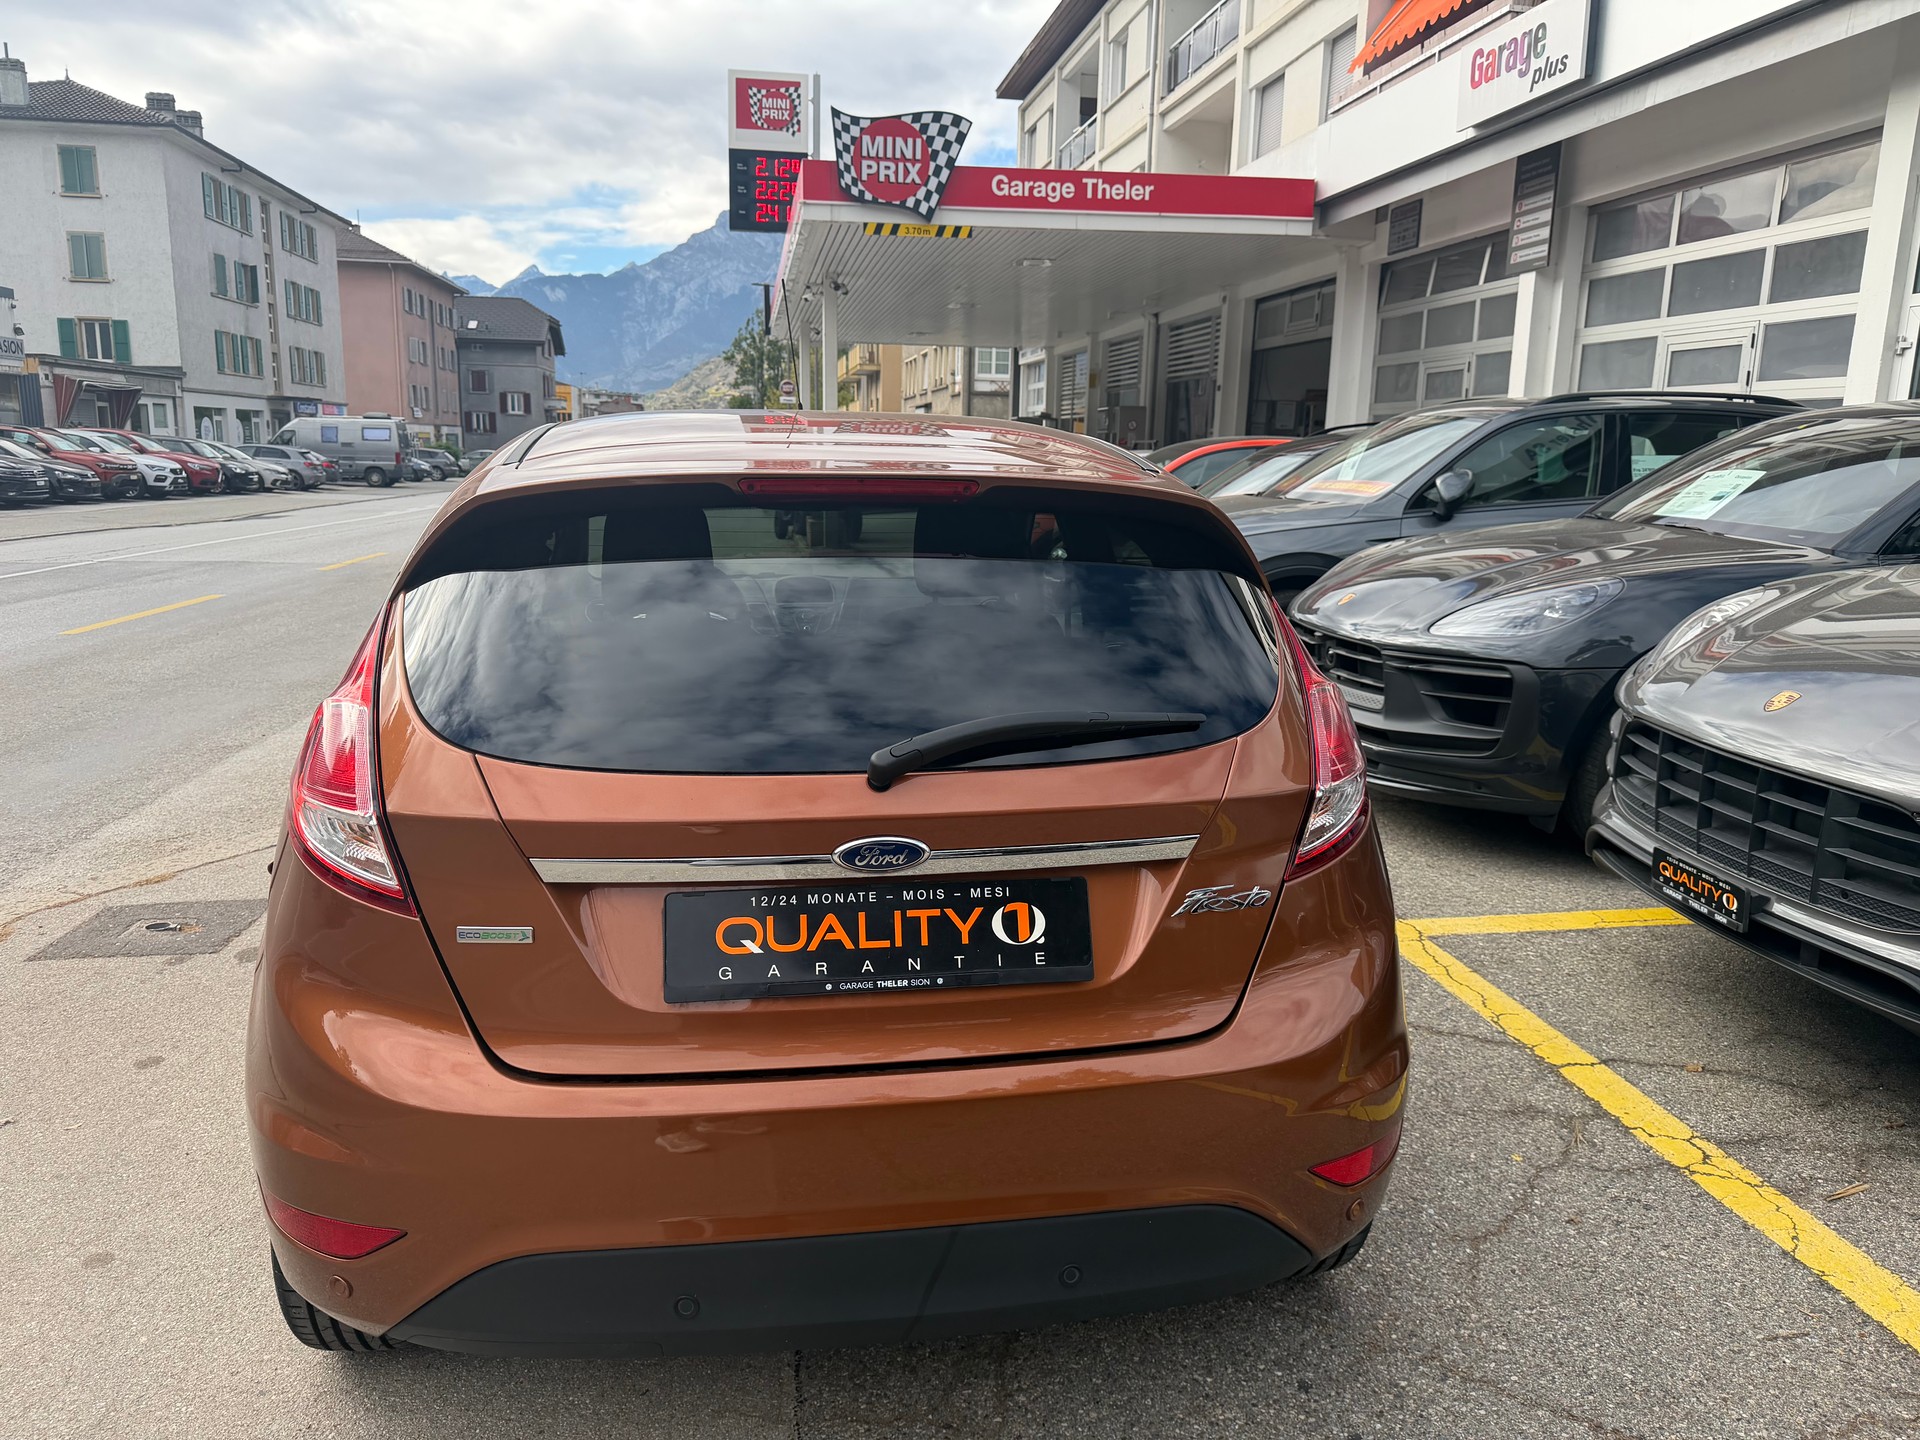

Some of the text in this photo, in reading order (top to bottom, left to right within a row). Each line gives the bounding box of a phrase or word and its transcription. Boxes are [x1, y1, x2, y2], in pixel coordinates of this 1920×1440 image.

[1470, 22, 1547, 90] Garage
[1529, 54, 1569, 93] plus
[762, 97, 790, 109] MINI
[762, 109, 790, 120] PRIX
[861, 135, 922, 160] MINI
[861, 160, 922, 185] PRIX
[991, 174, 1155, 203] Garage Theler
[855, 845, 908, 866] Ford
[1659, 861, 1722, 902] QUALITY
[750, 895, 798, 907] 12/24
[807, 891, 877, 905] MONATE
[903, 889, 945, 901] MOIS
[970, 887, 1010, 899] MESI
[1663, 886, 1683, 901] GARAGE
[1688, 900, 1708, 914] THELER
[715, 907, 984, 955] QUALITY
[839, 978, 930, 990] GARAGE THELER SION
